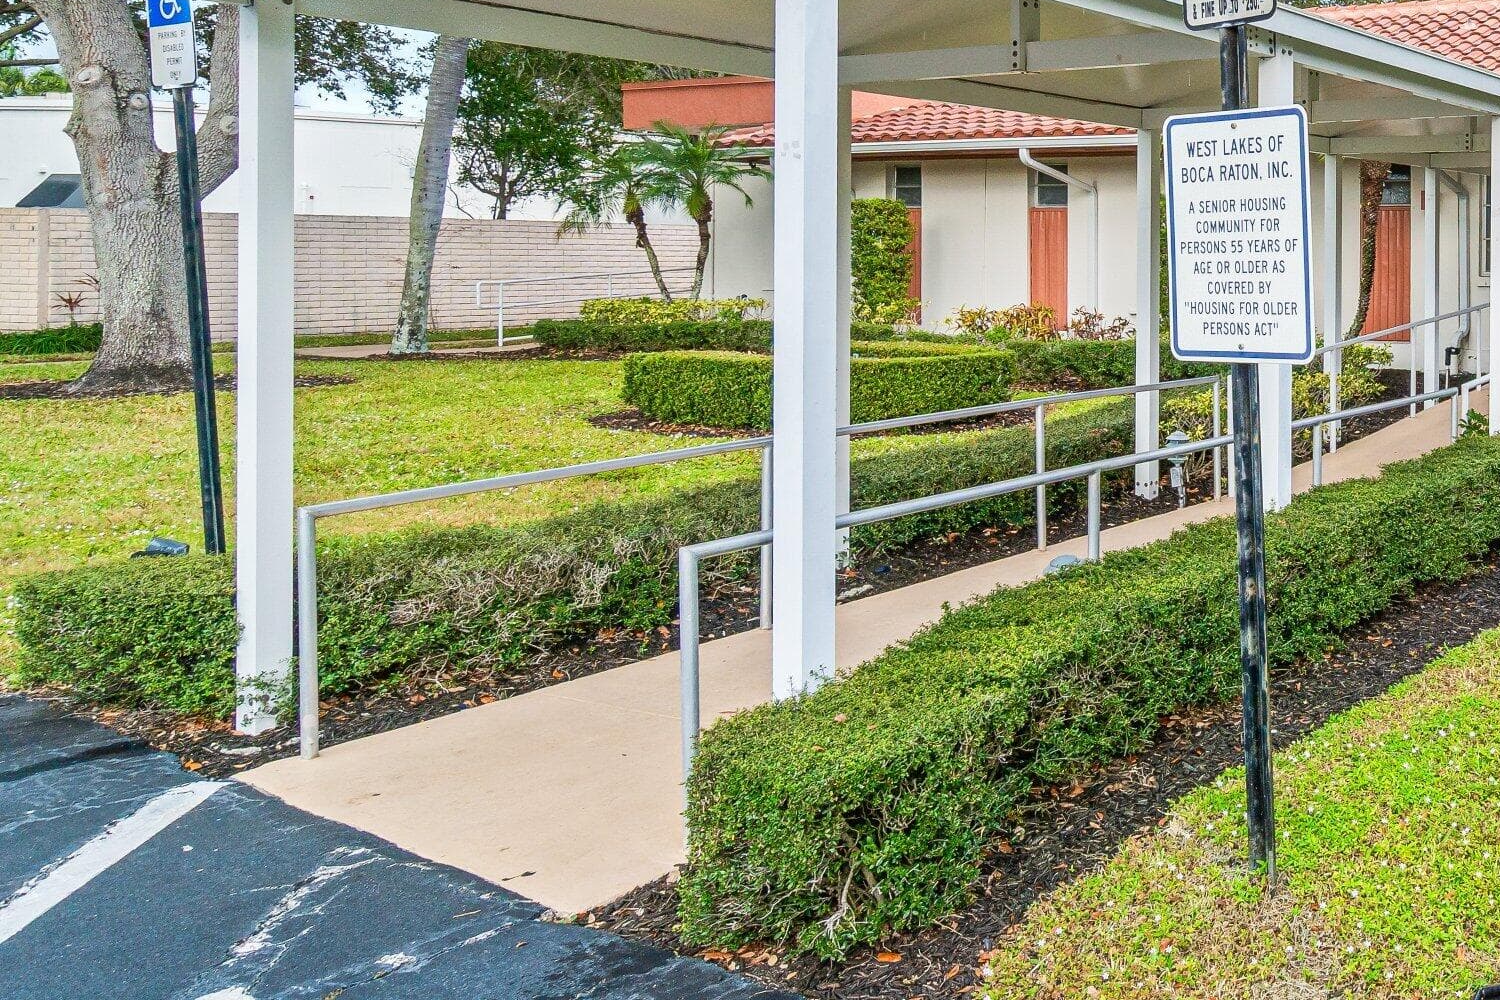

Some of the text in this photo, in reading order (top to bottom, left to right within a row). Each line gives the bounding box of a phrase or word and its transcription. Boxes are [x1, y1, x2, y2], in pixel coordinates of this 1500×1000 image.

[1193, 4, 1197, 19] &
[1201, 1, 1215, 18] FINE
[1219, 0, 1227, 16] UP
[1186, 135, 1285, 158] WEST LAKES OF
[1181, 166, 1214, 183] BOCA
[1267, 162, 1293, 178] INC.
[1189, 197, 1286, 214] A SENIOR HOUSING
[1196, 218, 1280, 234] COMMUNITY FOR
[1180, 239, 1298, 254] PERSONS 55 YEARS OF
[1193, 260, 1285, 274] AGE OR OLDER AS
[1207, 281, 1271, 295] COVERED BY
[1184, 302, 1298, 315] "HOUSING FOR OLDER
[1203, 322, 1279, 336] PERSONS ACT"
